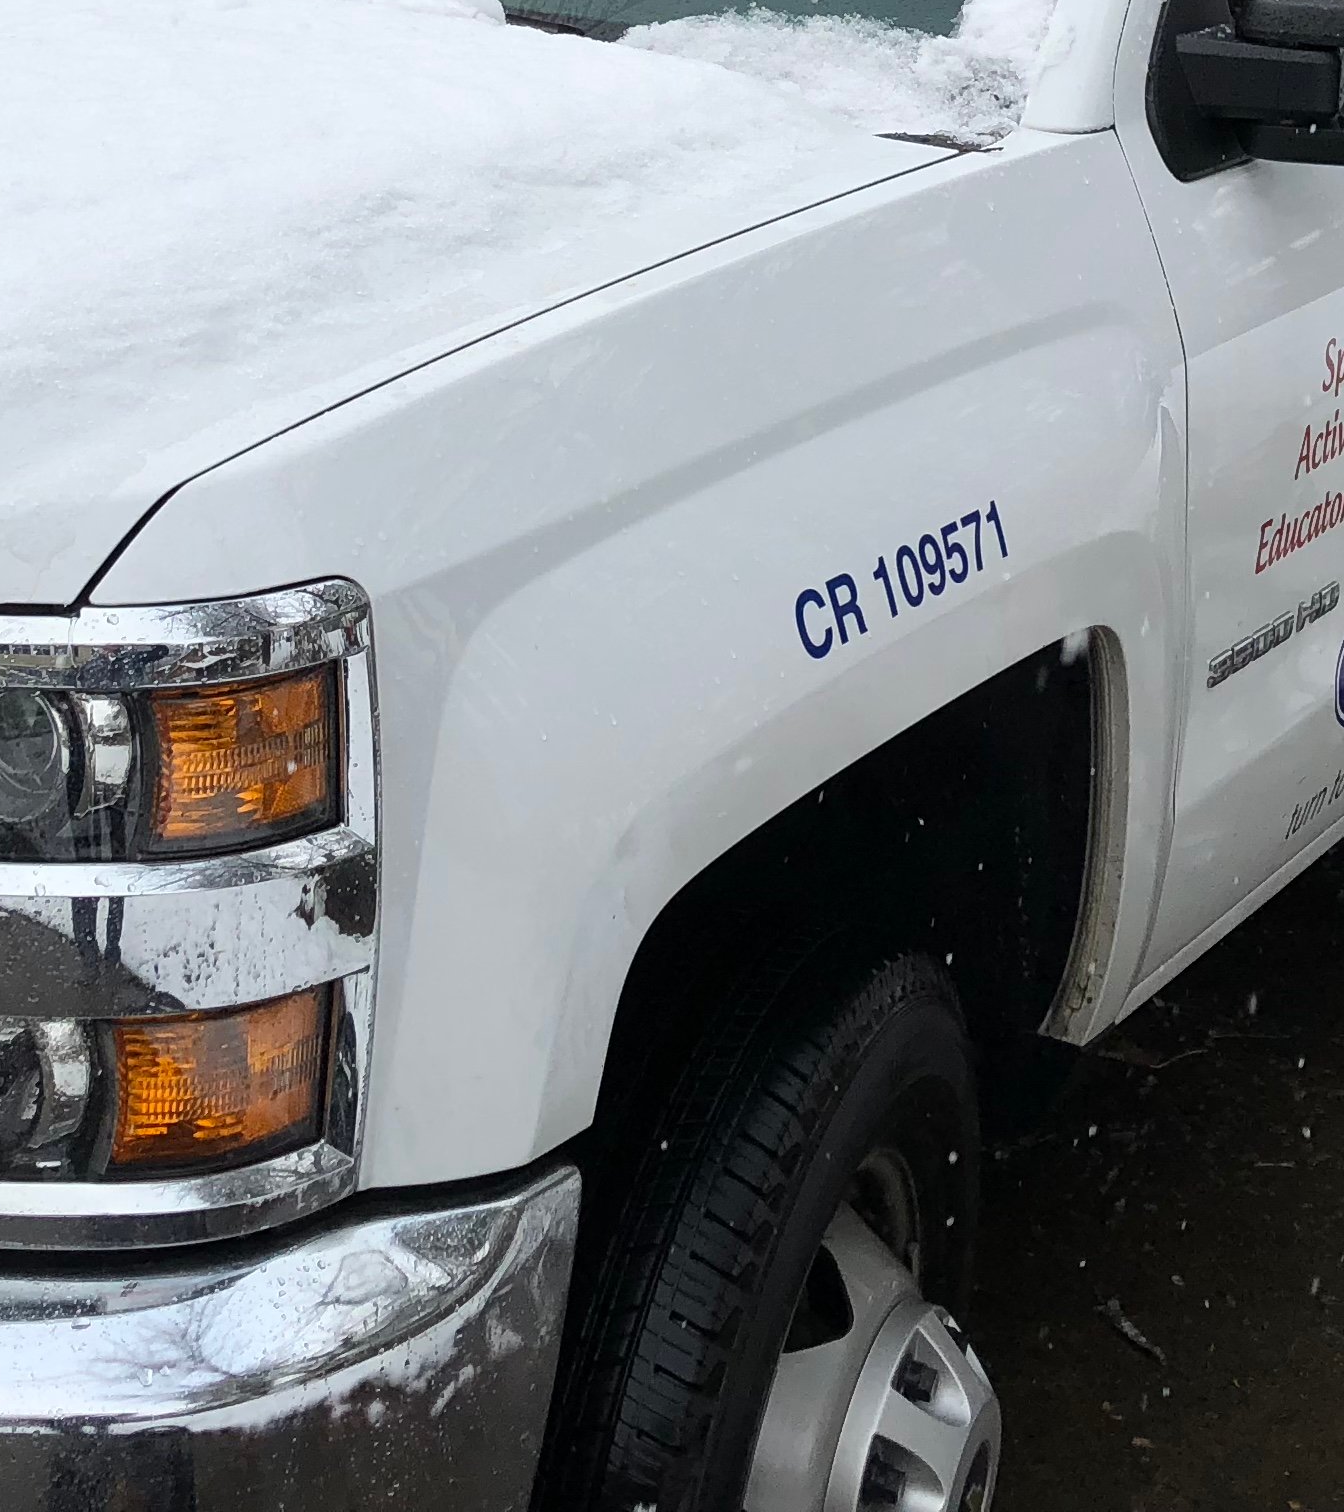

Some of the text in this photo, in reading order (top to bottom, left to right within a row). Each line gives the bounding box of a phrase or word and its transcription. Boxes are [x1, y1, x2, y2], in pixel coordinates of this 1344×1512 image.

[794, 499, 1009, 660] CR 109571
[1295, 580, 1340, 633] HD
[1284, 786, 1328, 840] turn
